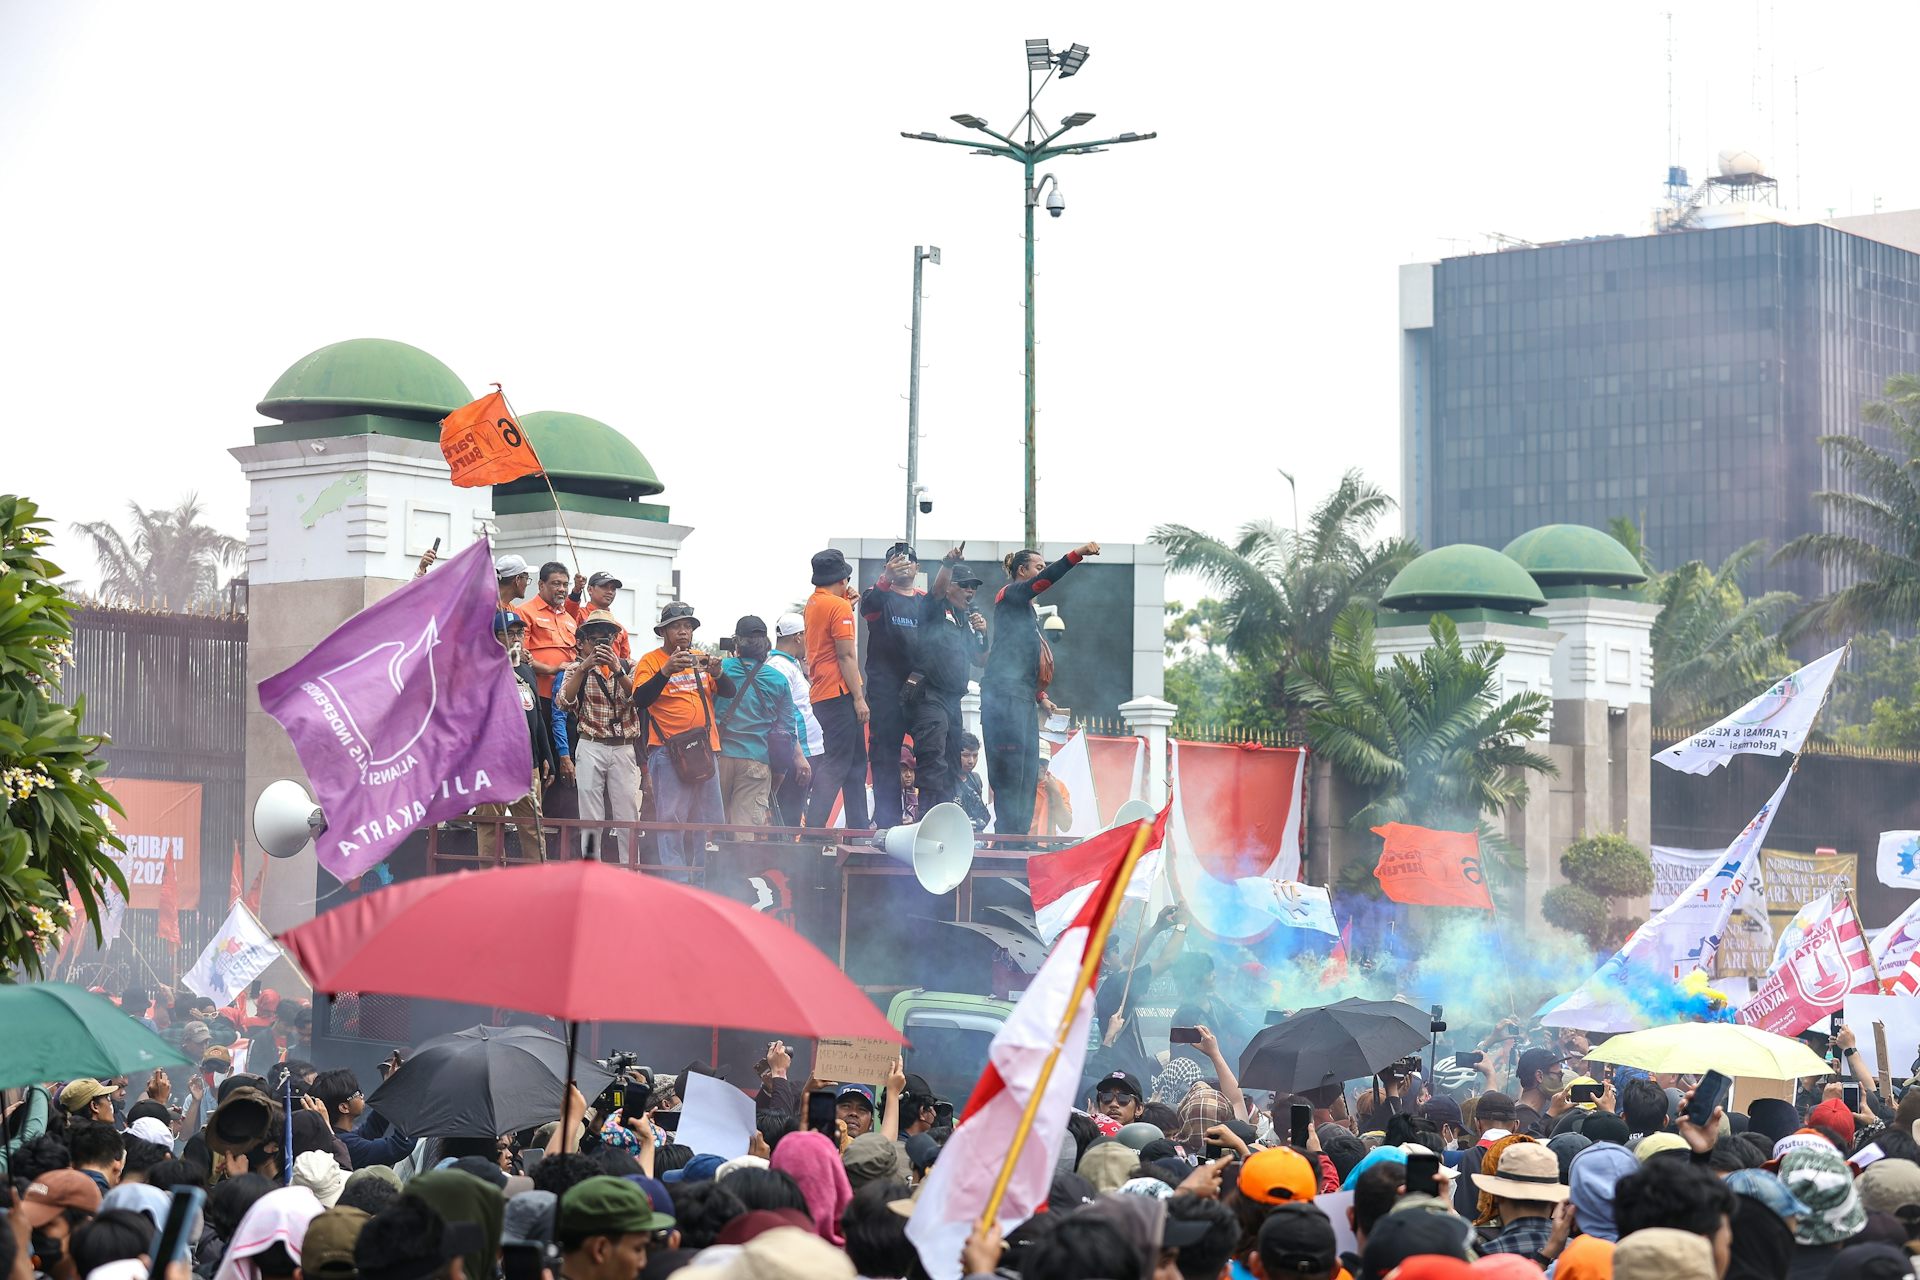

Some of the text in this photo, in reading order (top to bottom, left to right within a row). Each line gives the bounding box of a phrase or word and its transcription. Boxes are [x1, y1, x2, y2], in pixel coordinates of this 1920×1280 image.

[1767, 886, 1789, 902] ARE
[1792, 887, 1809, 903] WE
[1723, 953, 1746, 969] ARE
